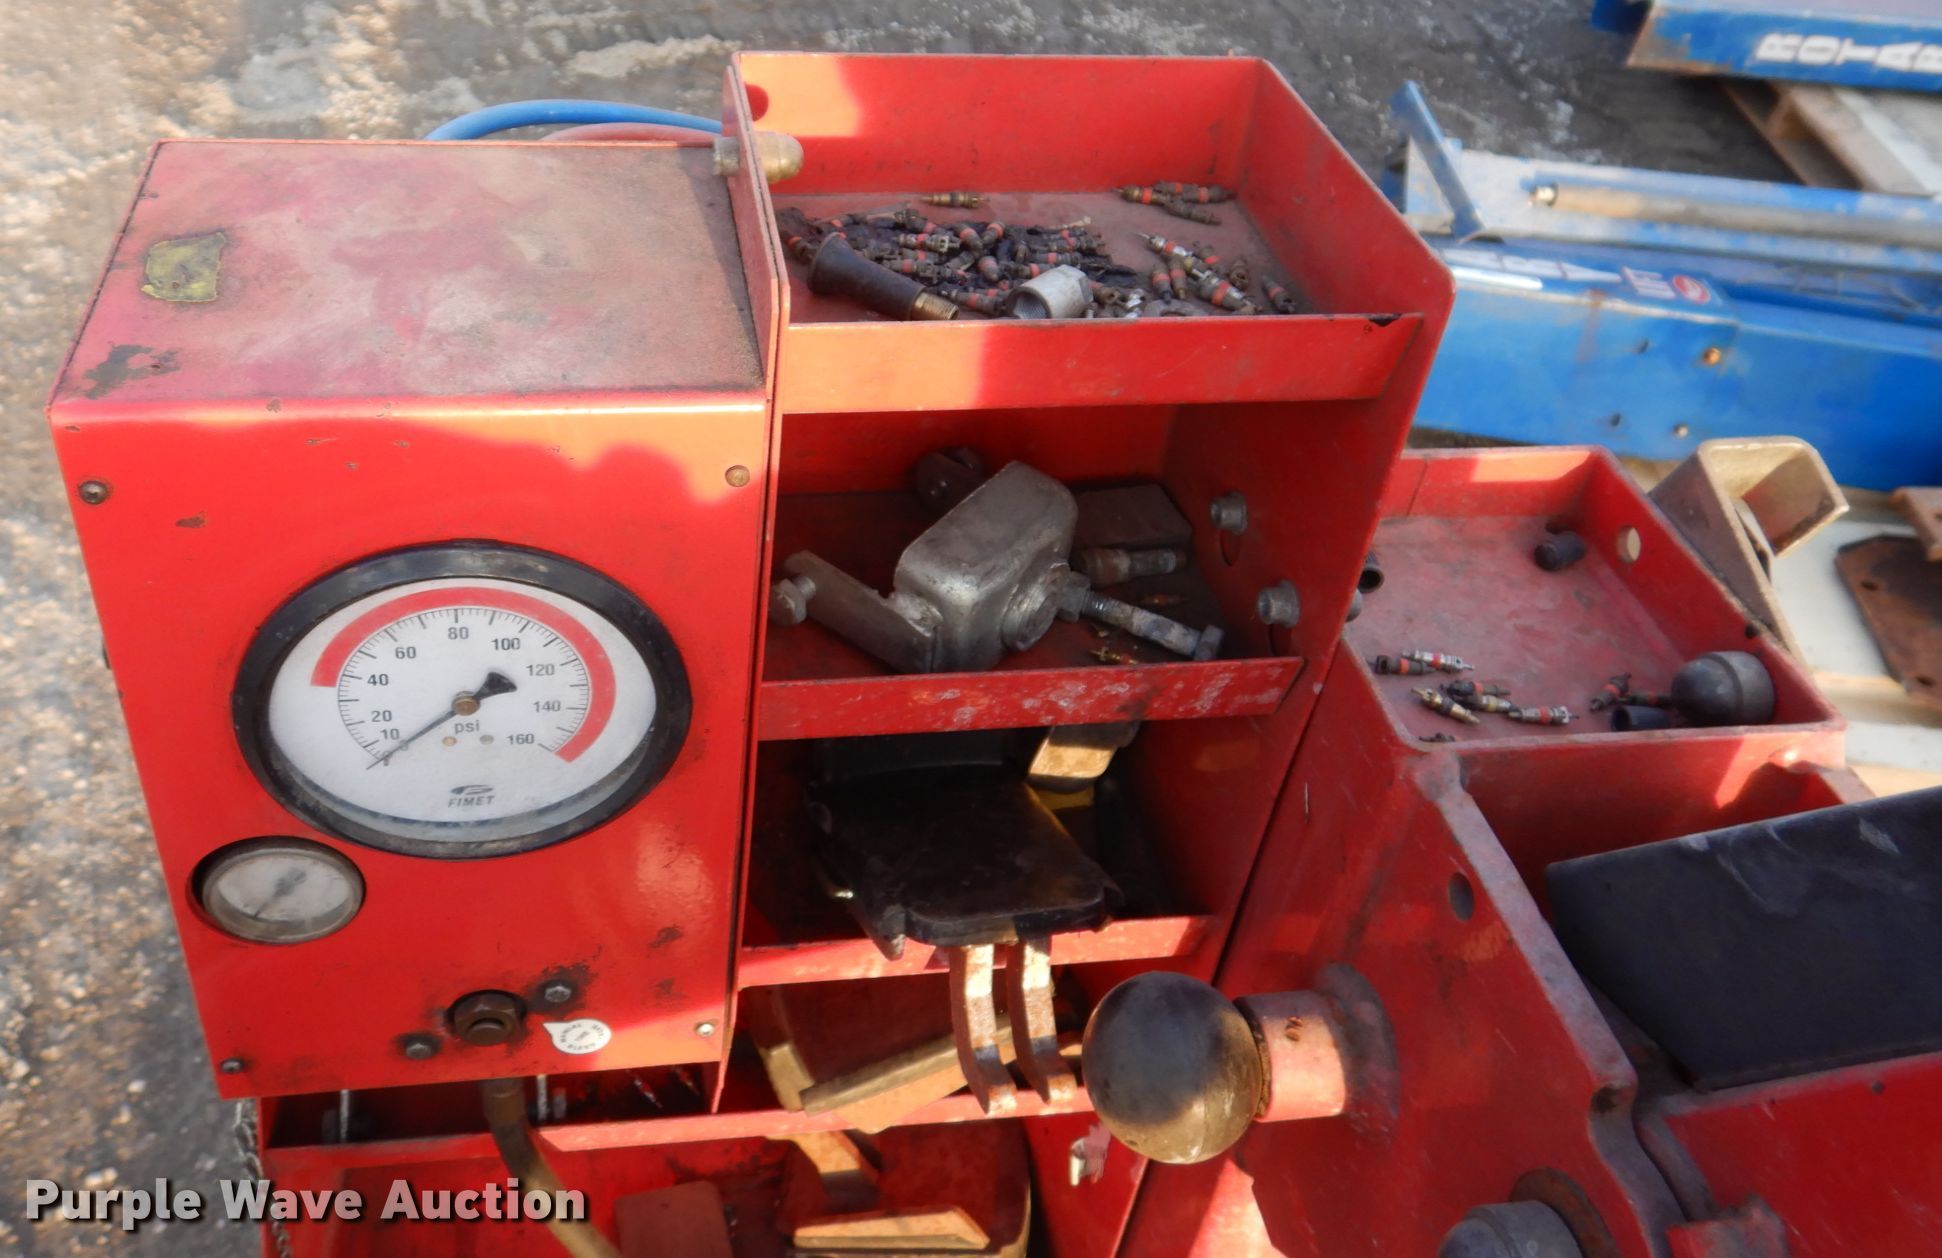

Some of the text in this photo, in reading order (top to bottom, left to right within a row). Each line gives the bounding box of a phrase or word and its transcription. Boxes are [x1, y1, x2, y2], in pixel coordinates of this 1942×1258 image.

[447, 626, 469, 640] 80
[491, 637, 521, 651] 100
[394, 646, 417, 660] 60
[526, 663, 555, 677] 120
[367, 673, 389, 687] 40
[533, 700, 561, 713] 140
[371, 710, 392, 723] 20
[454, 719, 480, 734] psi
[380, 728, 400, 740] 10
[506, 733, 535, 745] 160
[448, 795, 495, 808] FIMET
